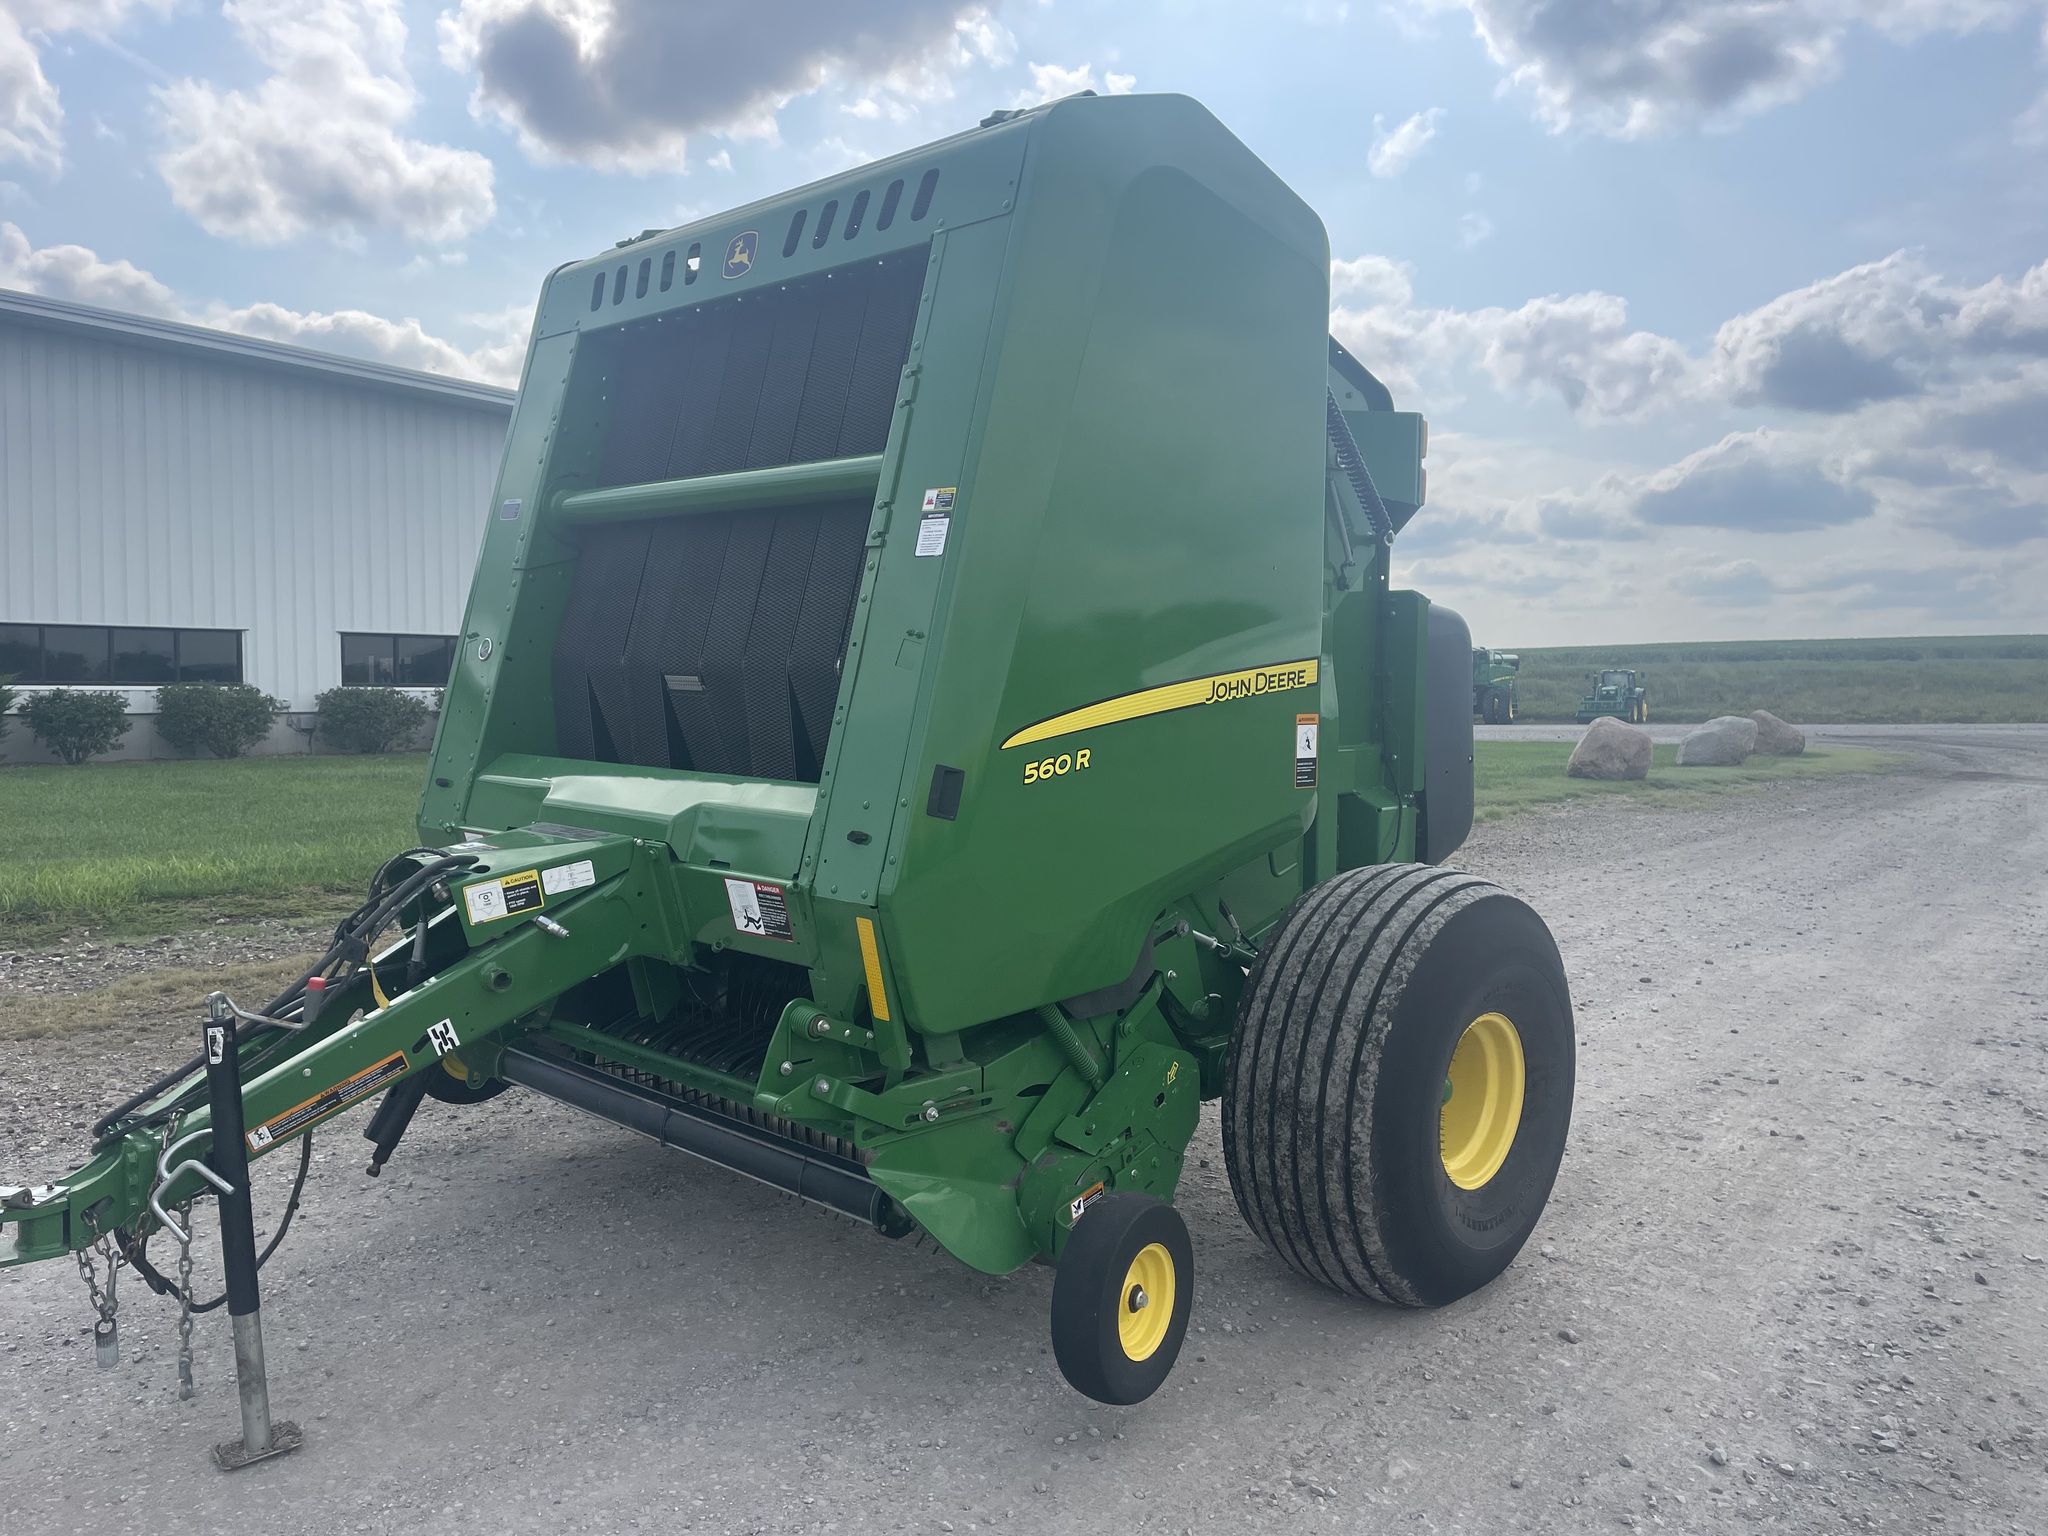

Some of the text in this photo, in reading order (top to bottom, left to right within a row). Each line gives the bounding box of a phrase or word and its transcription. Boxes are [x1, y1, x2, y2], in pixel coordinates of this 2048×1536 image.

[1205, 669, 1307, 702] JOHN DEERE
[1023, 748, 1091, 785] 560 R
[510, 874, 533, 884] CAUTION
[325, 1080, 350, 1095] WARNING
